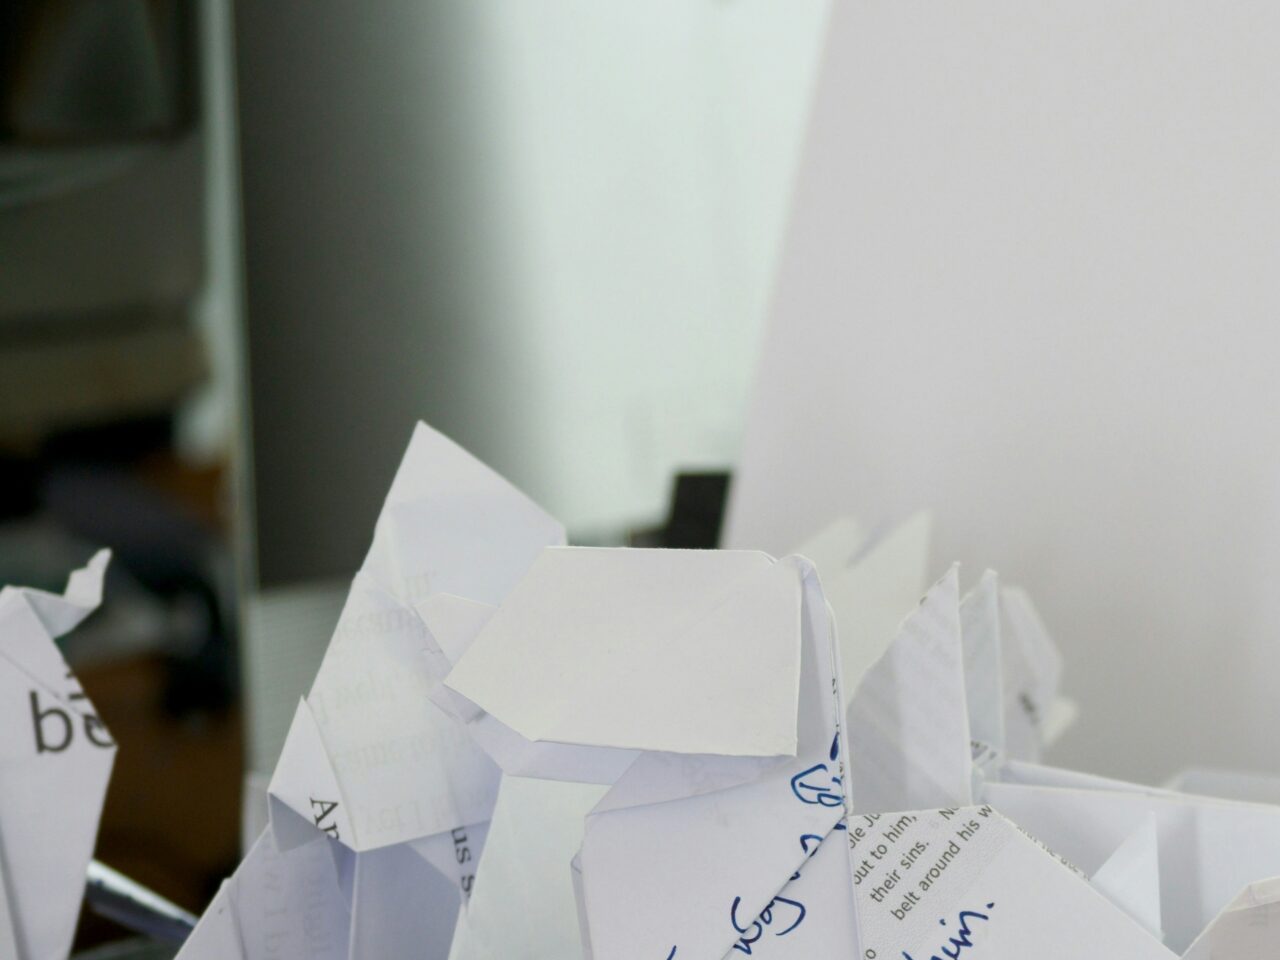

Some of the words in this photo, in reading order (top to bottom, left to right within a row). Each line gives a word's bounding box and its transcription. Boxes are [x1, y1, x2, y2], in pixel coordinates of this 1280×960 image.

[870, 844, 888, 860] to
[882, 815, 917, 843] him,
[870, 869, 901, 903] their
[900, 841, 930, 870] sins.
[890, 891, 921, 921] belt
[918, 840, 961, 891] around
[956, 820, 981, 842] his
